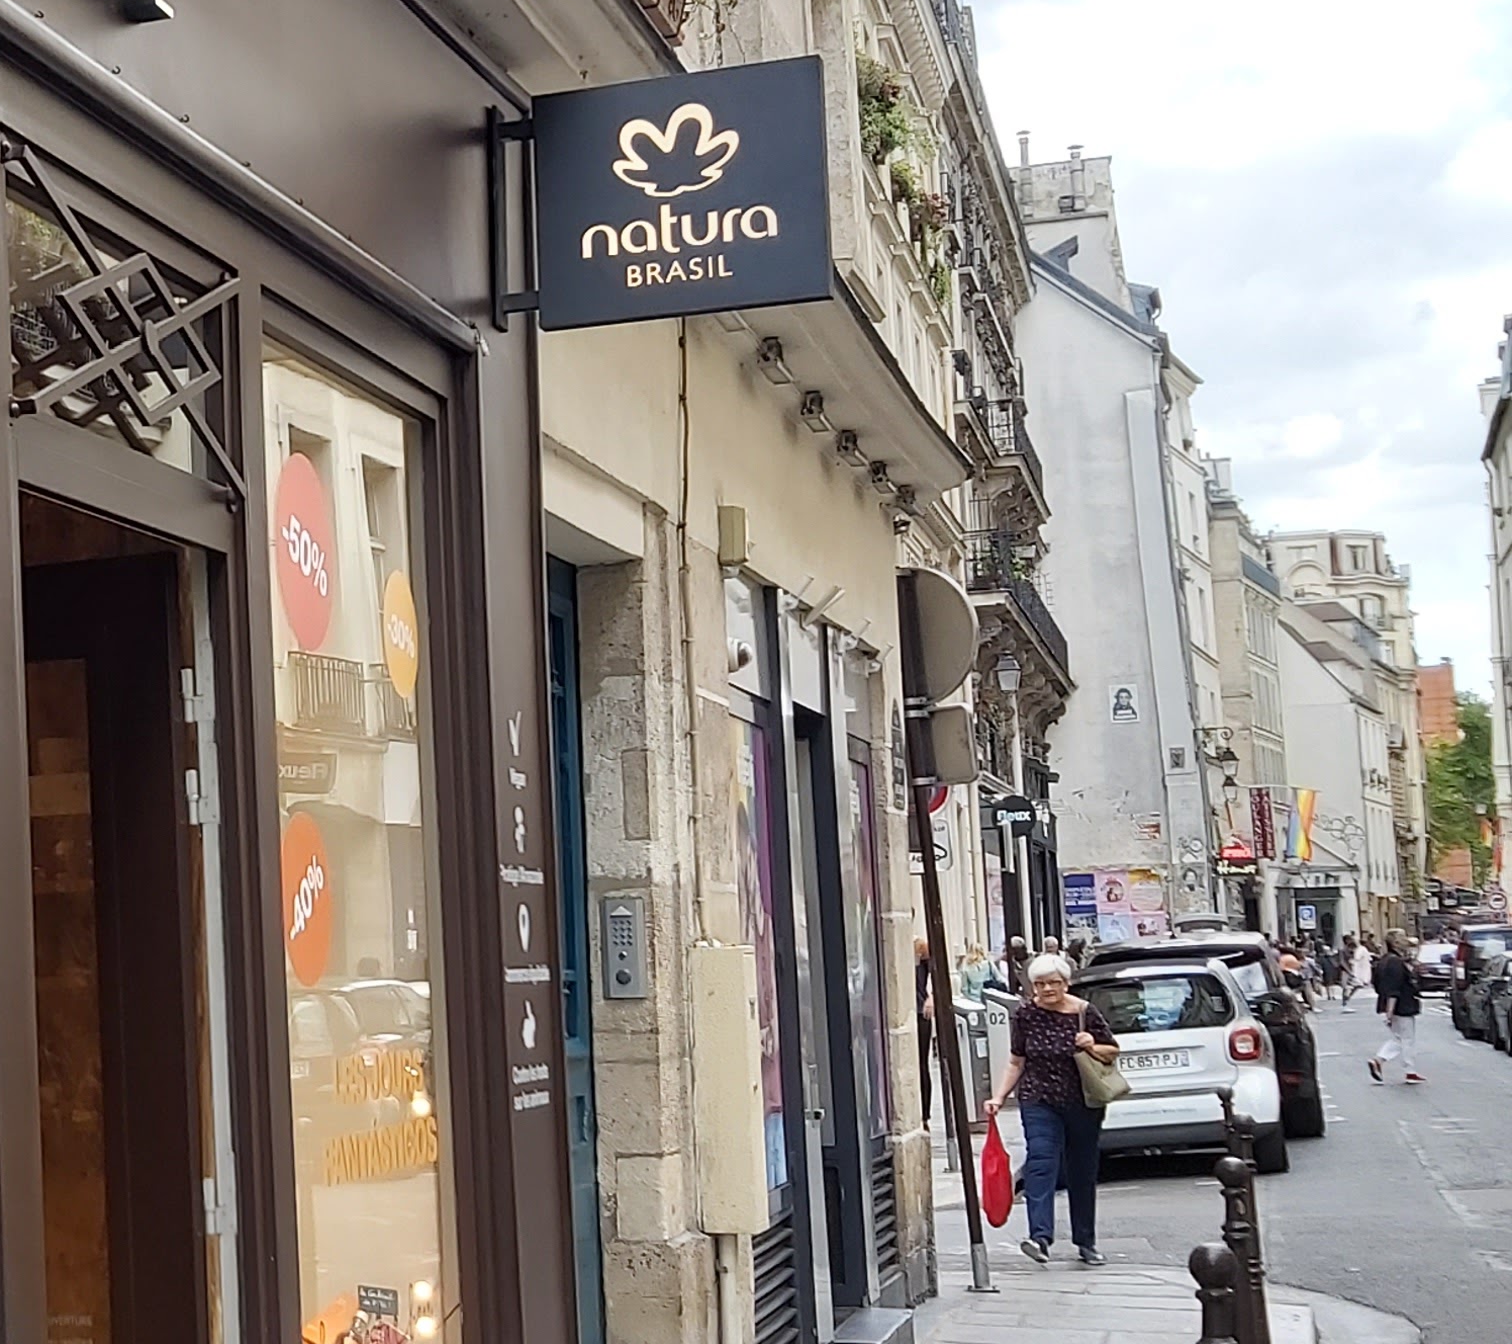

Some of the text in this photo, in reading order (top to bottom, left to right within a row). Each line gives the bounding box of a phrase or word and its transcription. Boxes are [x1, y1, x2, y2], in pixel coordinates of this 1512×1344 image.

[581, 204, 778, 258] natura
[626, 254, 733, 287] BRASIL
[282, 514, 327, 597] -50%
[387, 613, 415, 659] -30%
[290, 855, 324, 940] -40%
[989, 1012, 1006, 1025] 02
